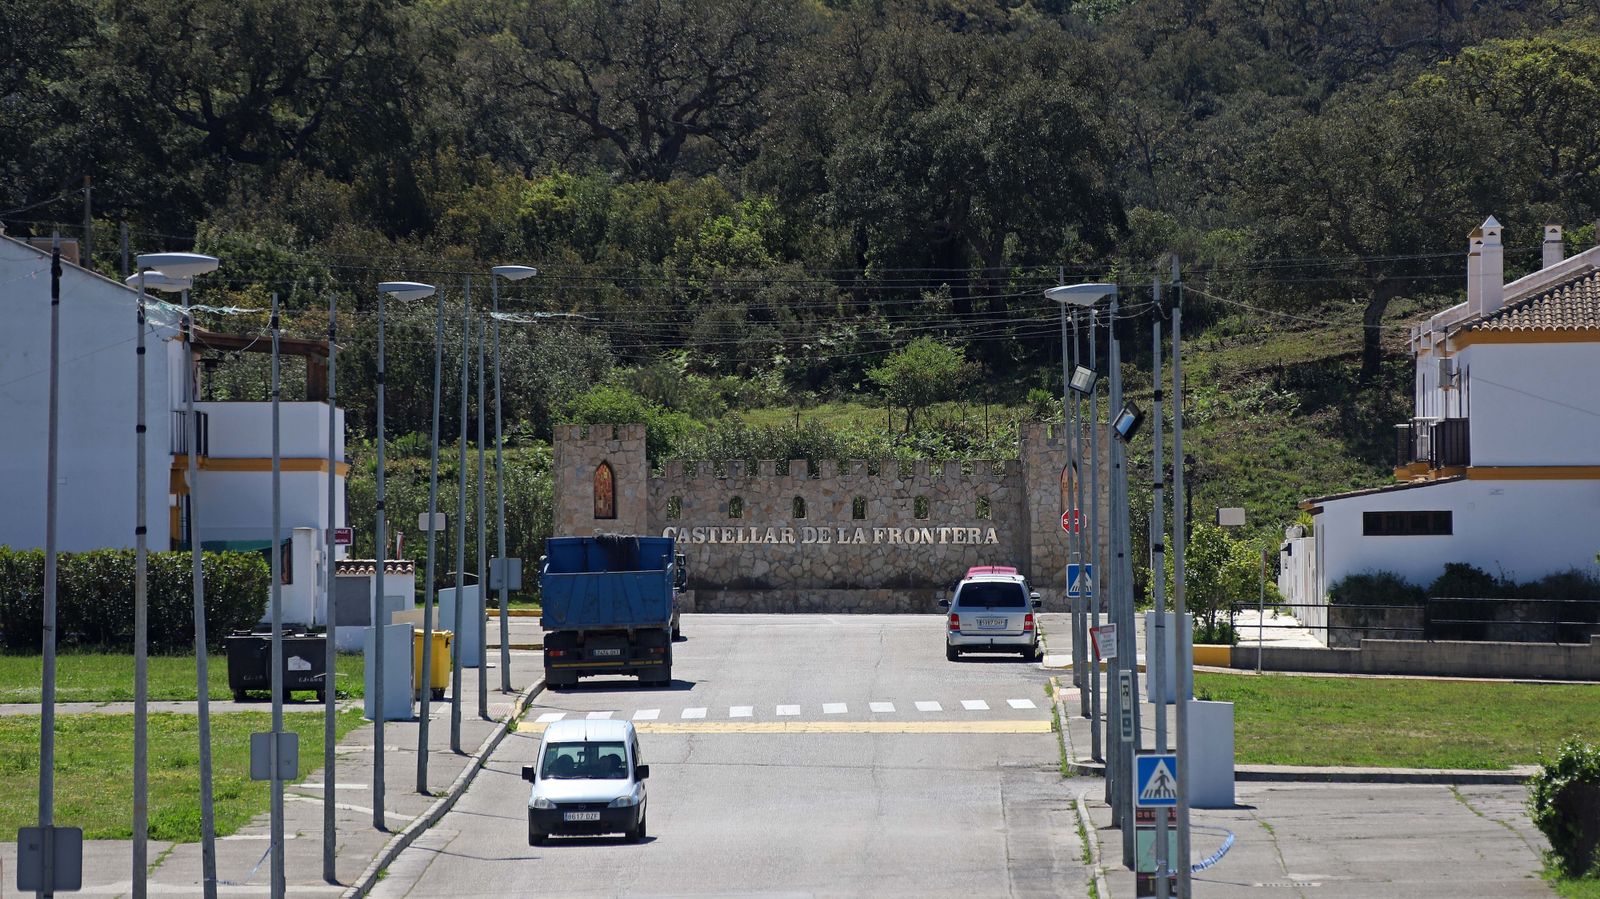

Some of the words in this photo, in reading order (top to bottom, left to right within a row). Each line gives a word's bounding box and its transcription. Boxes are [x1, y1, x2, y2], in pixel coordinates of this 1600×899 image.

[662, 526, 796, 544] CASTELLAR
[801, 526, 832, 544] DE
[837, 527, 867, 544] LA
[872, 527, 999, 545] FRONTERA
